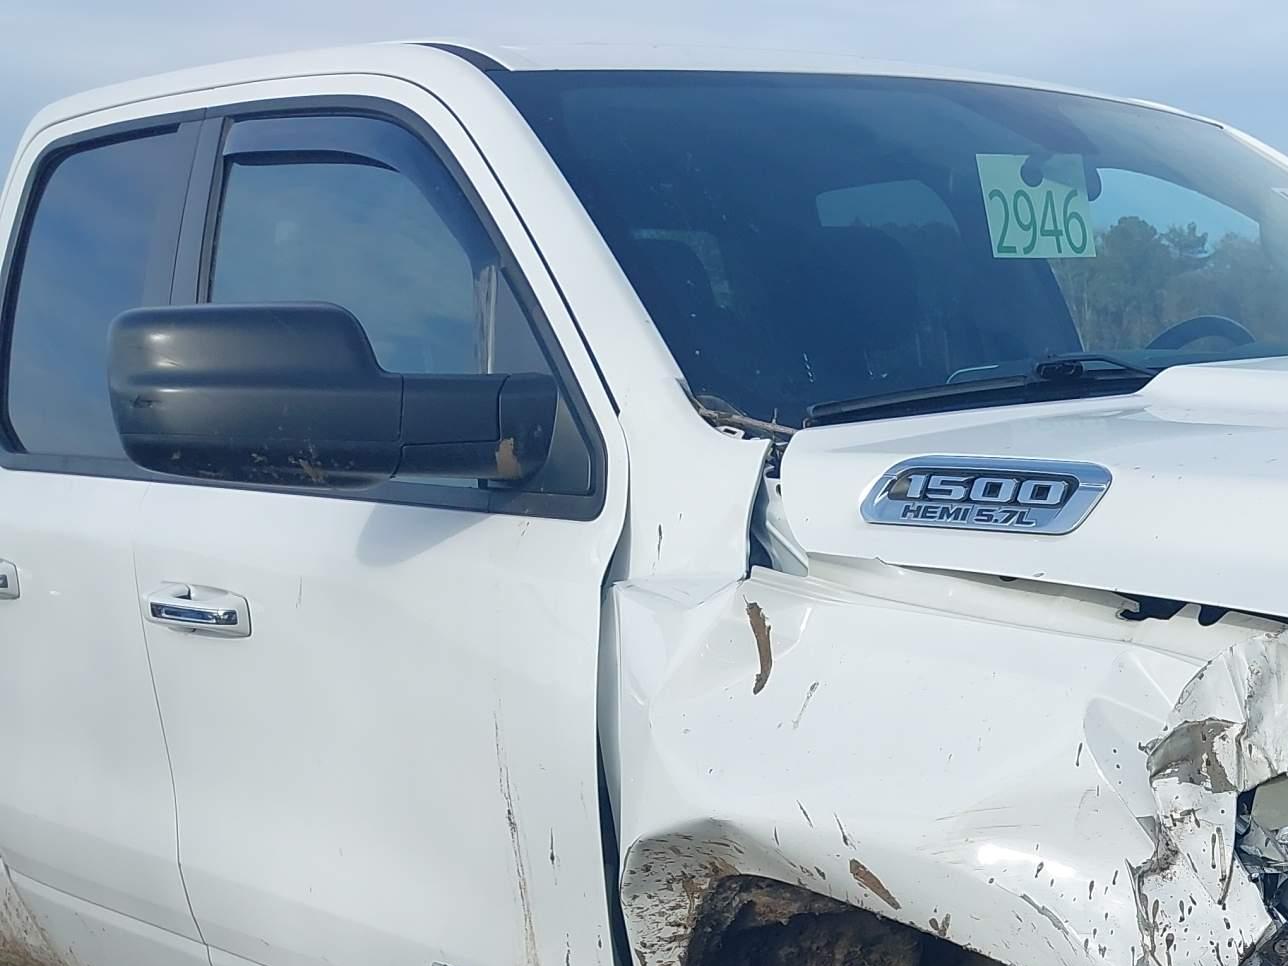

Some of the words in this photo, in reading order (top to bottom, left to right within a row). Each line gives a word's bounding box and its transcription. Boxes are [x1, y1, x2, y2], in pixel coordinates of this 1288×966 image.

[988, 189, 1088, 255] 2946
[906, 473, 1069, 506] 1500
[901, 503, 969, 522] HEMI
[973, 507, 1037, 527] 5.7L
